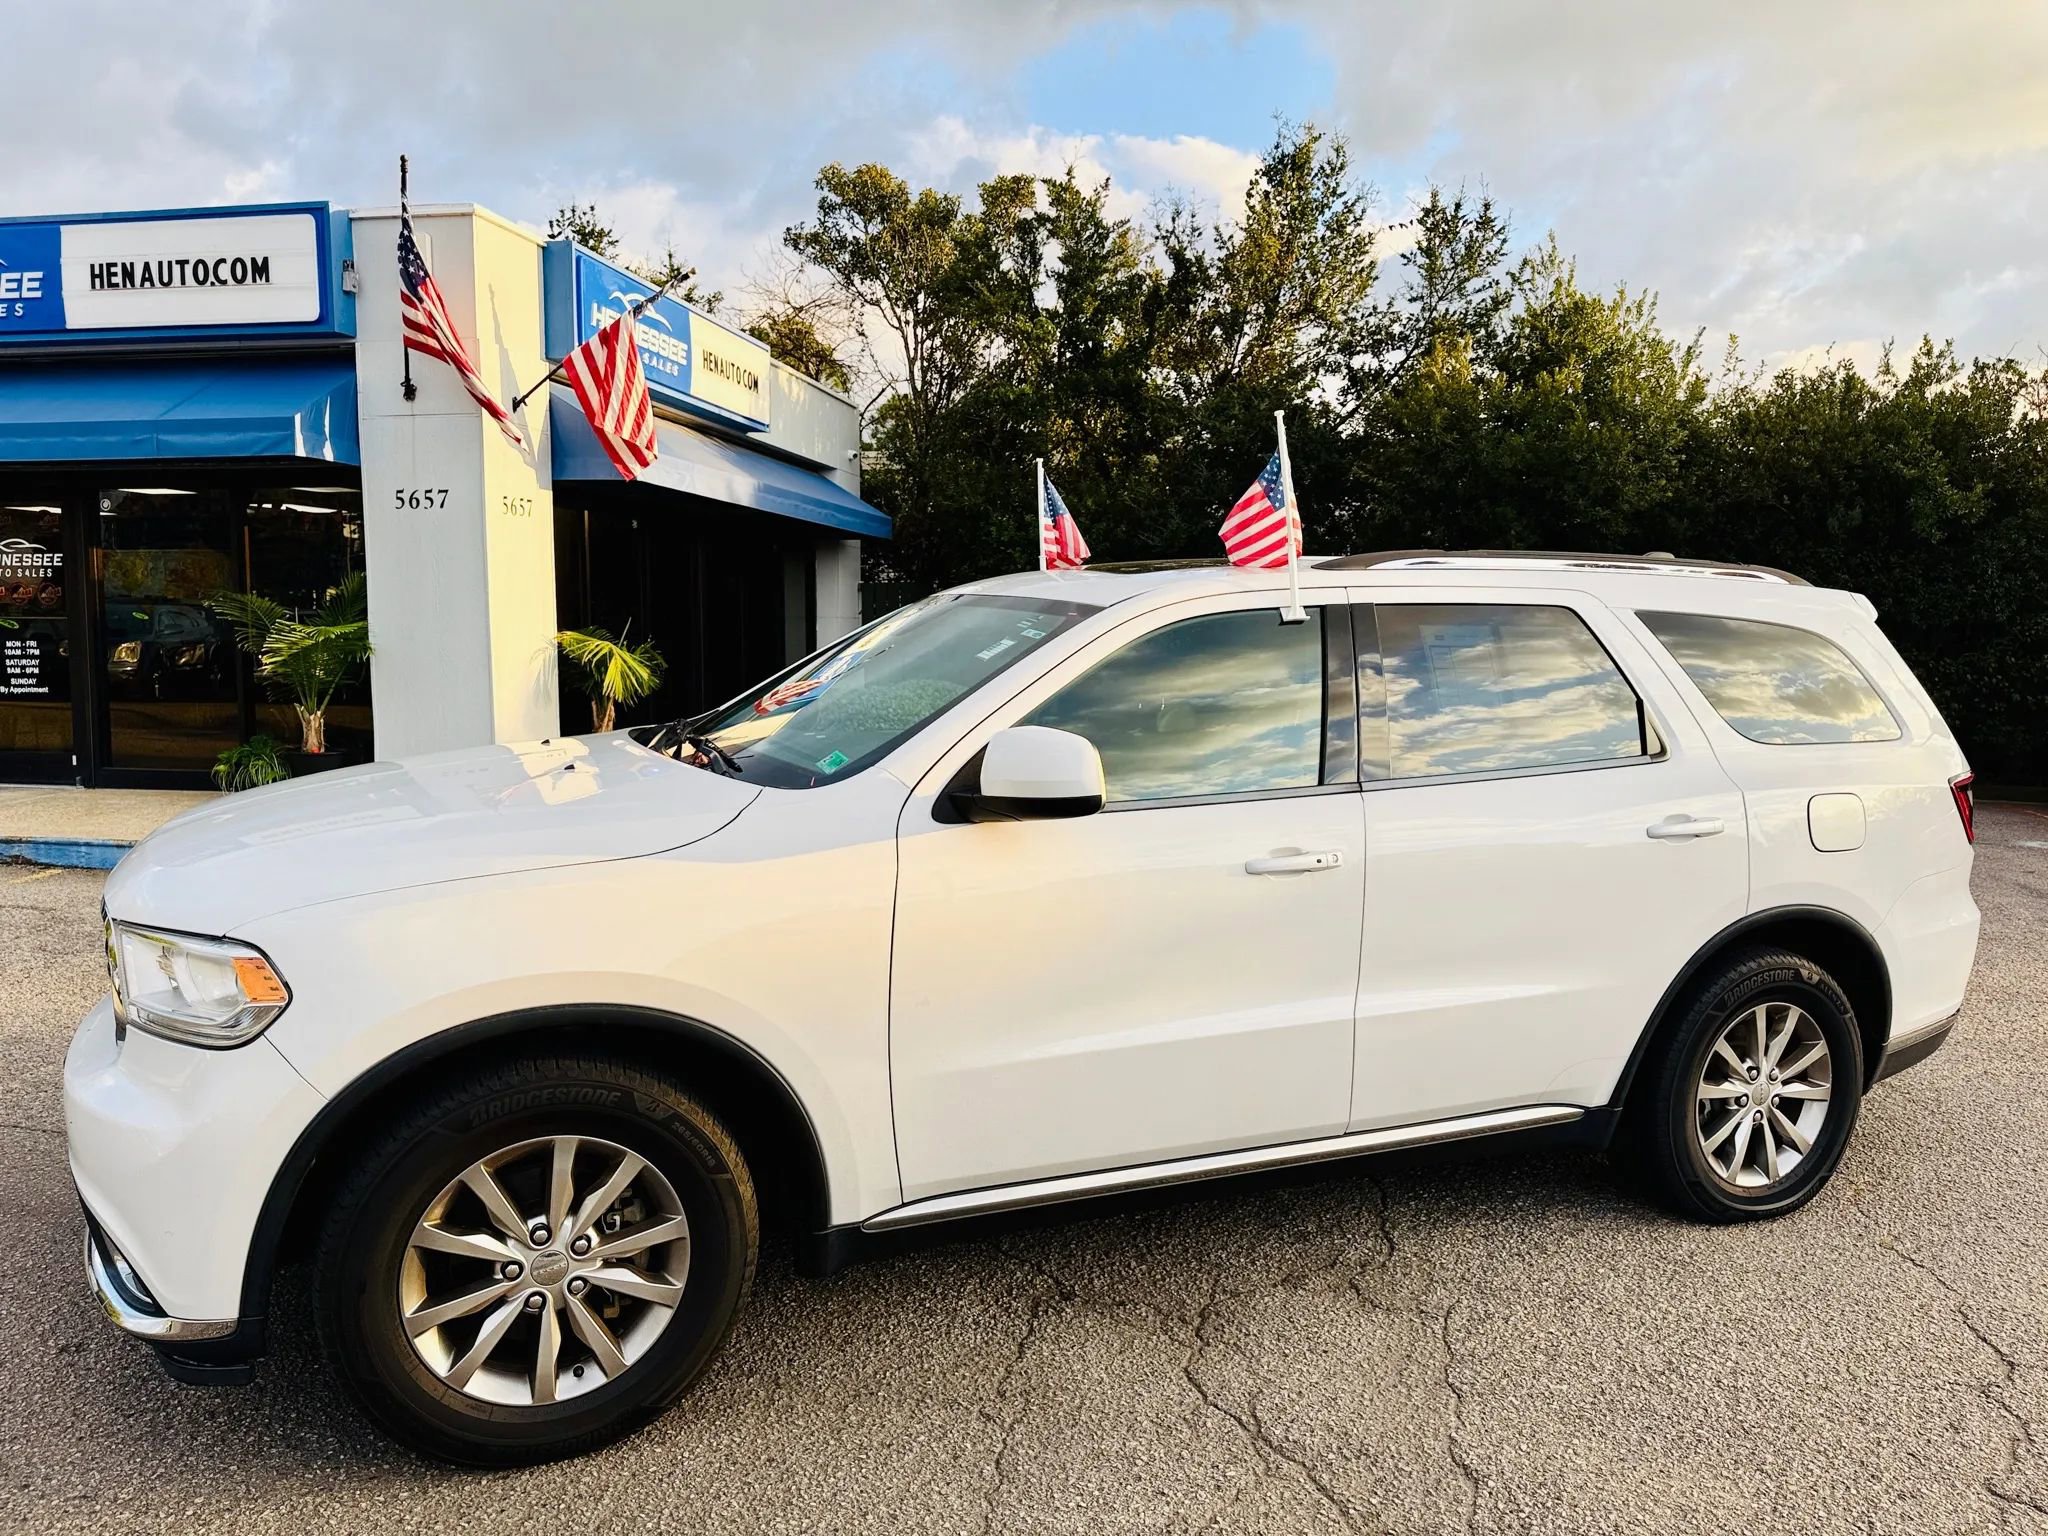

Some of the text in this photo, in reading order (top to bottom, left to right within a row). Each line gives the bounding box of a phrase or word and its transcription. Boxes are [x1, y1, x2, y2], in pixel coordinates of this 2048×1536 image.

[89, 256, 271, 290] HENAUTO.COM
[591, 302, 689, 366] HEESSEE
[642, 352, 680, 377] SALES
[395, 488, 450, 510] 5657
[502, 495, 534, 518] 5657
[17, 568, 53, 578] SALES
[4, 648, 22, 656] 10AM
[26, 648, 40, 656] 7PM
[6, 640, 22, 648] MON
[26, 640, 37, 648] FRI
[0, 686, 49, 694] By Appointment
[1724, 969, 1795, 1008] BRIDGESTONE
[468, 1087, 622, 1127] BRIDGESTONE
